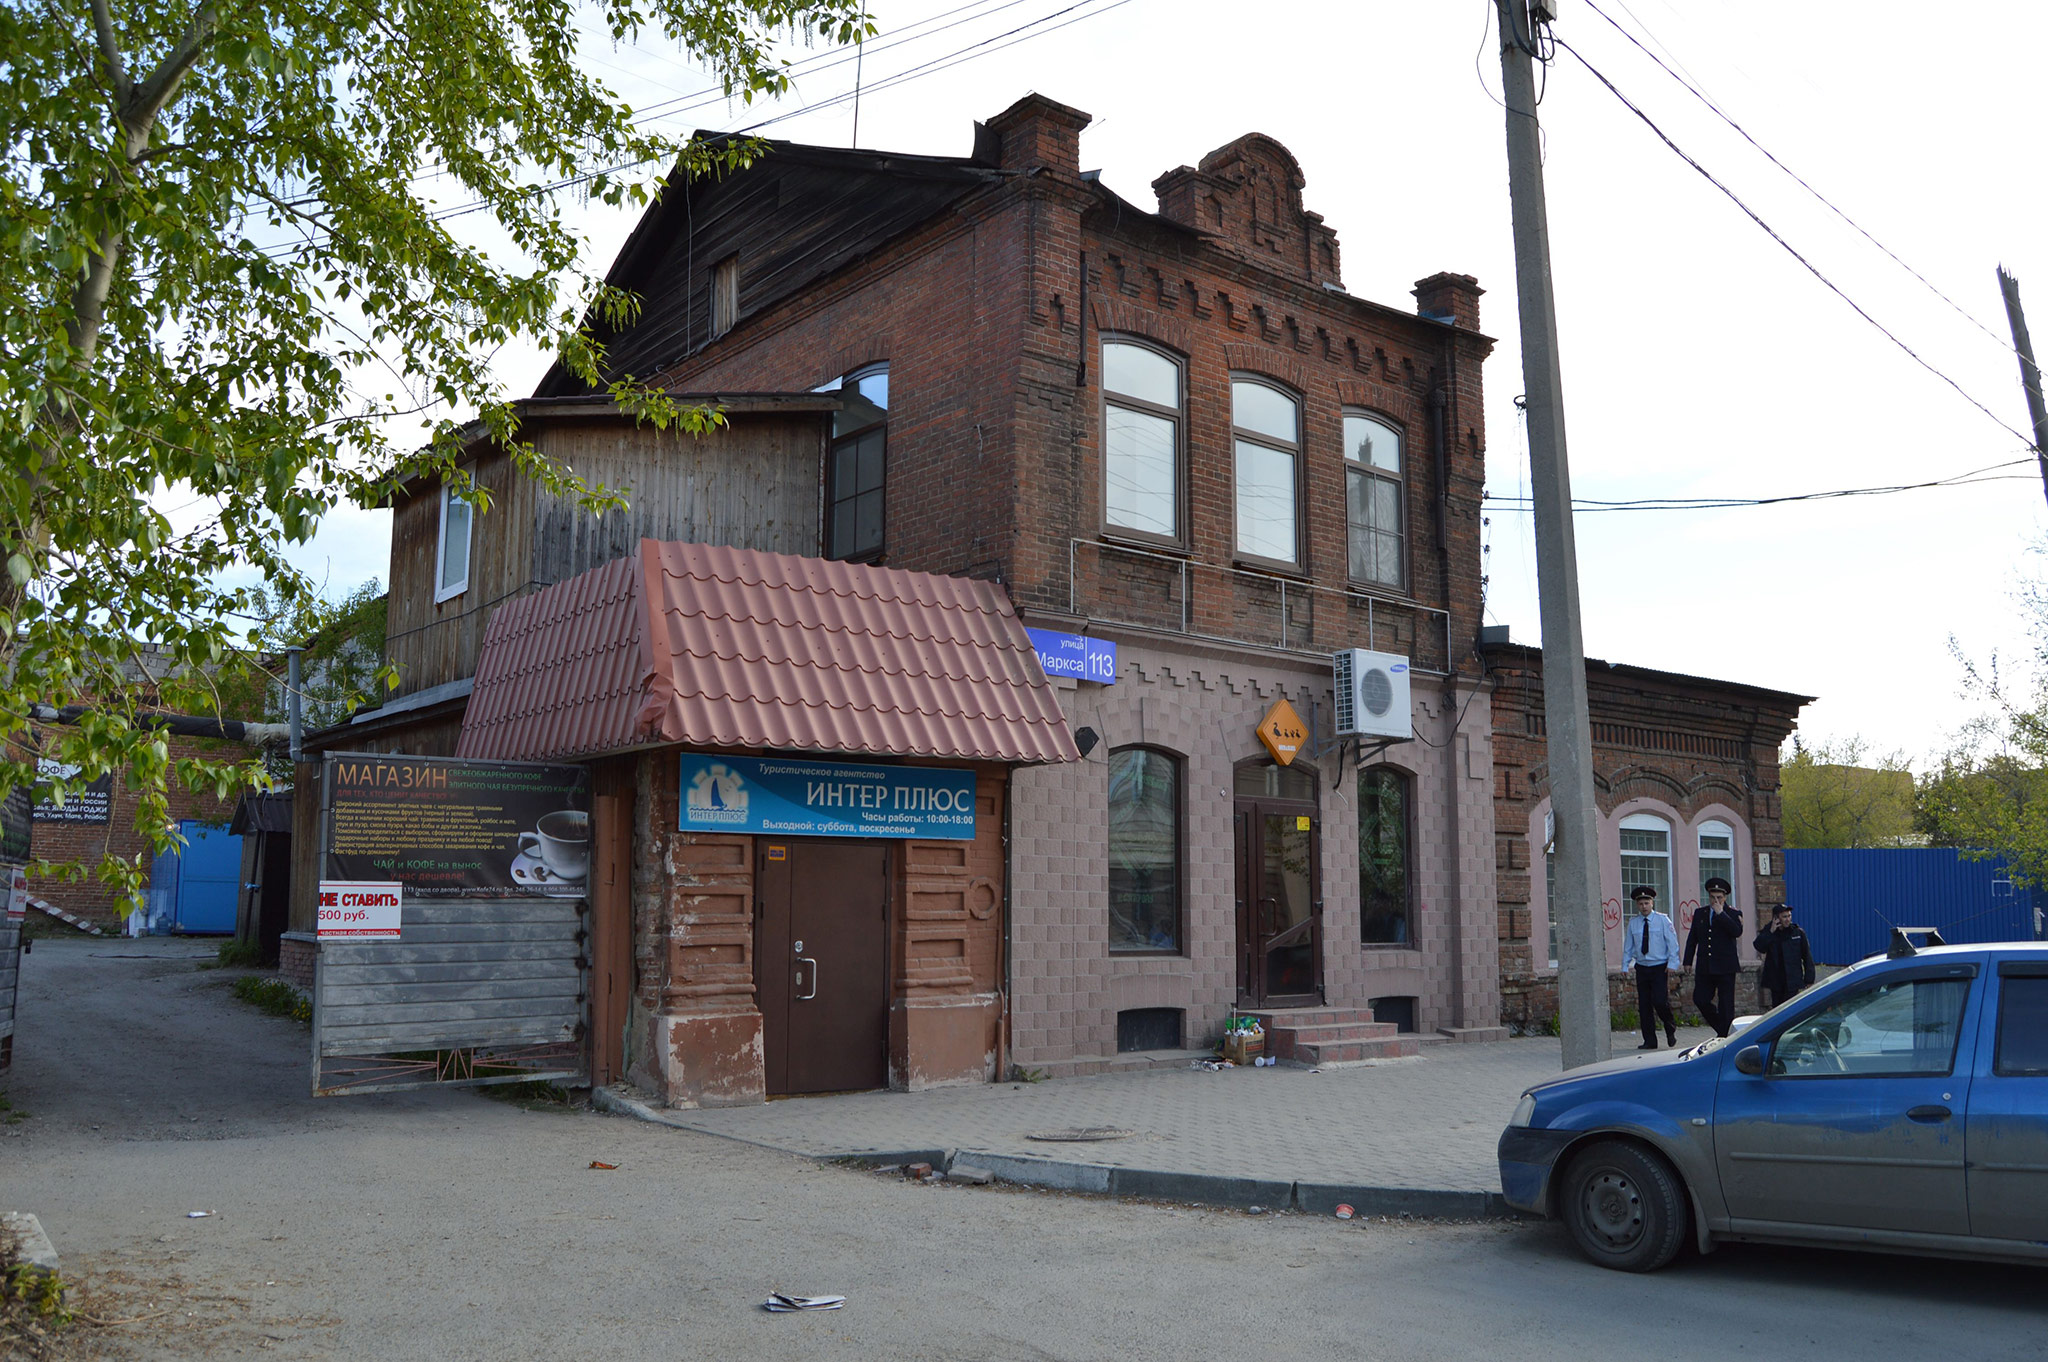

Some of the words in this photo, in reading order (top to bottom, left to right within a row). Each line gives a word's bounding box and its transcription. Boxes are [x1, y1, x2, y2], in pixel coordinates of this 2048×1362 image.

[1060, 639, 1084, 650] улица
[1088, 651, 1114, 677] 113
[337, 763, 447, 788] МАГАЗИН
[759, 763, 832, 777] Туристическое
[833, 769, 886, 780] агентство
[448, 780, 486, 791] ЭЛИТНОГО
[487, 782, 501, 791] ЧАЯ
[502, 783, 553, 793] БЕЗУПРЕЧНОГО
[807, 781, 888, 808] ИНТЕР
[894, 786, 969, 812] ПЛЮС
[690, 811, 717, 820] ИНТЕР
[719, 812, 745, 821] ПЛЮС
[861, 812, 886, 822] Часы
[888, 813, 924, 824] работы:
[926, 814, 974, 825] 10:00-18:00
[762, 819, 815, 831] Выходной:
[817, 821, 857, 833] суббота,
[858, 824, 915, 835] воскресенье
[373, 858, 395, 869] ЧАЙ
[406, 859, 436, 870] КОФЕ
[452, 863, 483, 871] вынос
[399, 871, 416, 880] нас
[418, 872, 465, 882] дешевле!
[319, 892, 338, 907] НЕ
[342, 893, 399, 907] СТАВИТЬ
[318, 909, 341, 921] 500
[344, 910, 370, 922] руб.
[348, 930, 398, 938] собственность
